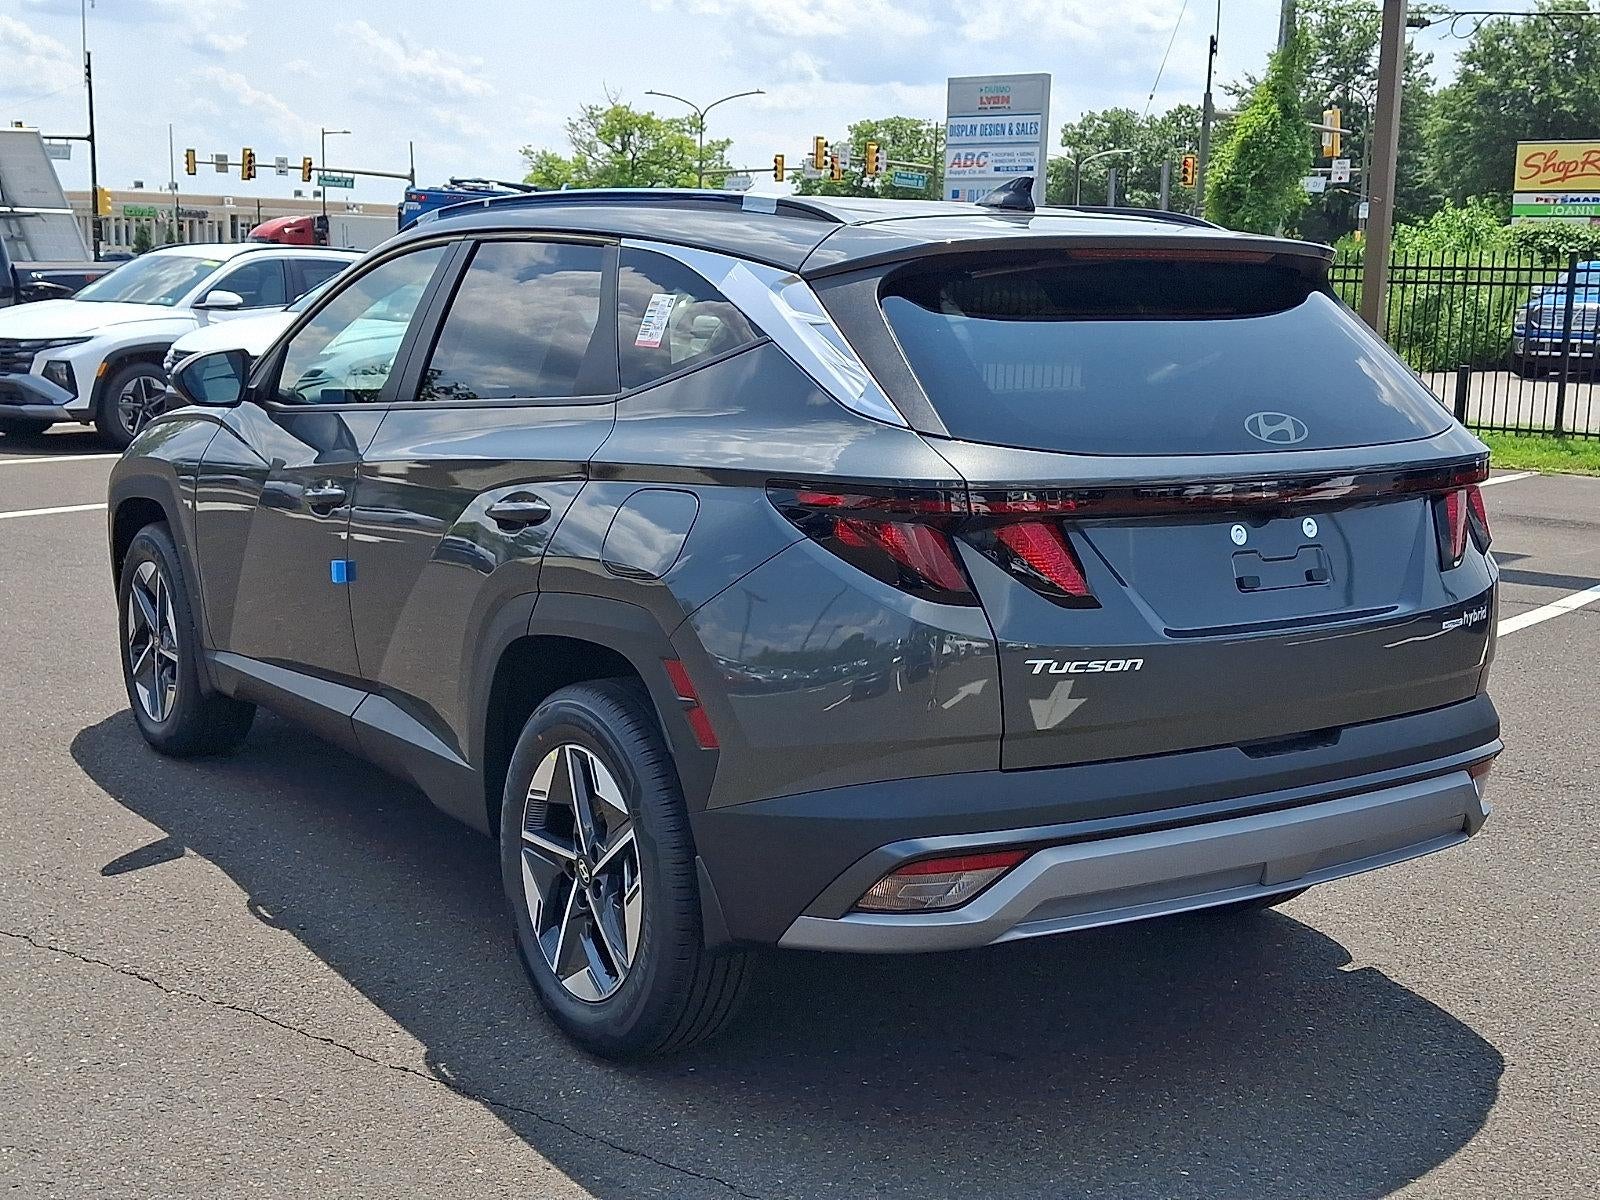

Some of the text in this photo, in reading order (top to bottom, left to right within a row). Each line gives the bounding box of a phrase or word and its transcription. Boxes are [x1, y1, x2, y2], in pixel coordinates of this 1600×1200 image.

[949, 121, 1039, 137] DISPLAY DESIGN & SALES
[948, 151, 989, 168] ABC
[1547, 205, 1595, 215] JOANN
[1463, 605, 1487, 626] hybrid
